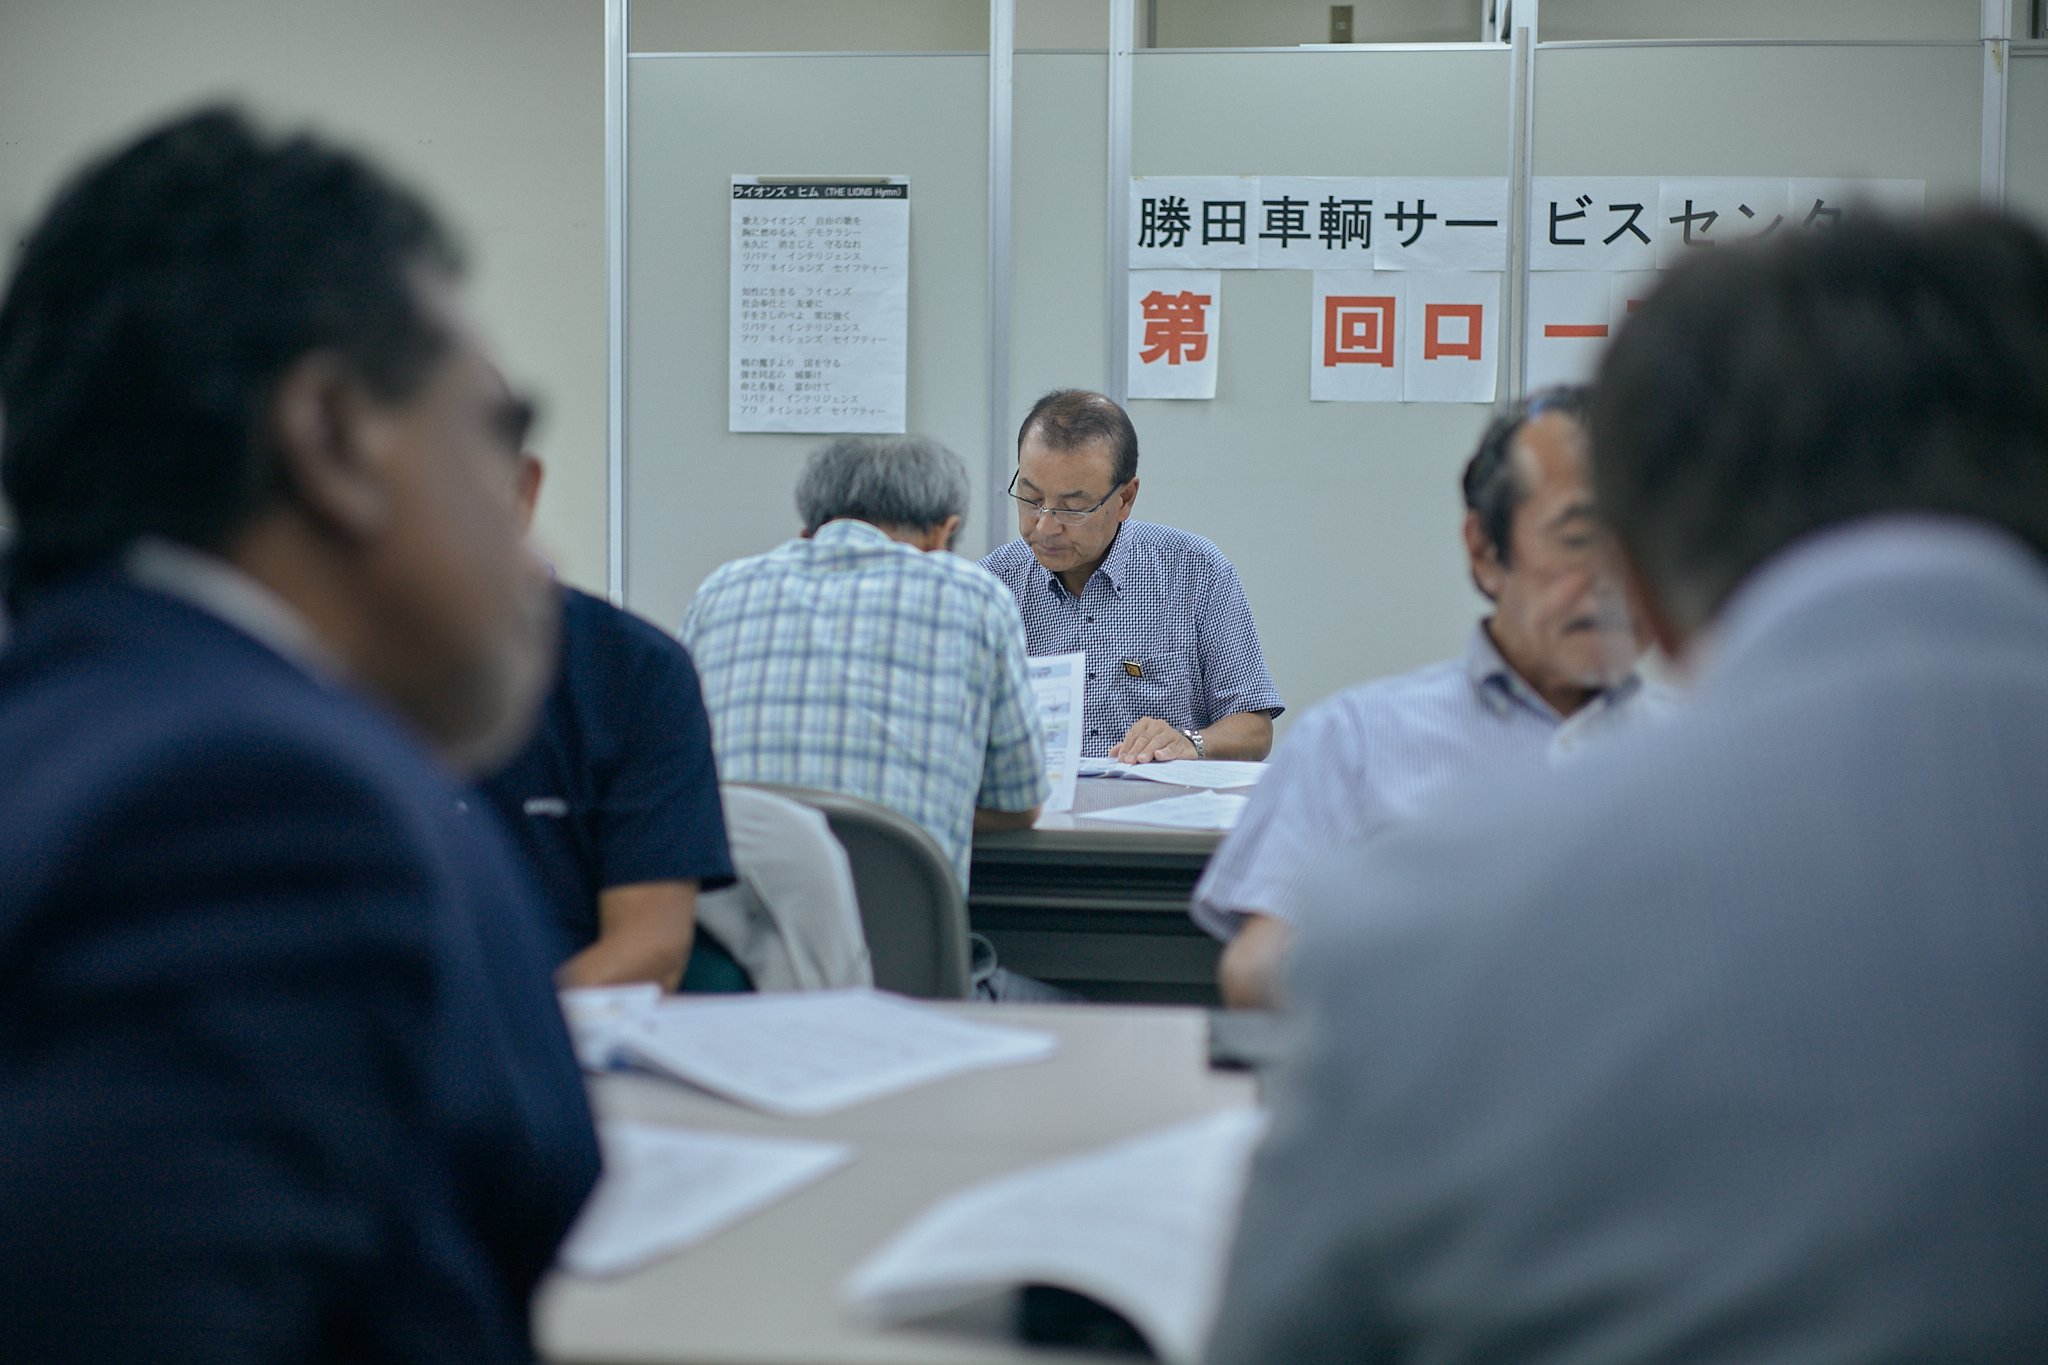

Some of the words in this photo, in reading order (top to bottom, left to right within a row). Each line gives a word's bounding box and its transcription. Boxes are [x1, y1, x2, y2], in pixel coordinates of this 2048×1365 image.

[734, 186, 819, 198] ライオンズ・ヒム
[847, 186, 873, 198] LIONS
[742, 216, 807, 226] 歌えライオンズ
[816, 216, 862, 226] 自由の歌を
[806, 228, 862, 237] デモクラシー
[742, 240, 769, 249] 永久に
[779, 240, 815, 249] 消さじと
[824, 240, 862, 249] 守るなれ
[788, 252, 861, 261] インテリジェンス
[742, 264, 760, 273] アワ
[770, 264, 824, 273] ネイションズ
[834, 264, 888, 273] セイフティー
[742, 287, 796, 297] 知性に生きる
[806, 287, 852, 297] ライオンズ
[741, 299, 787, 309] 社会奉仕と
[797, 299, 823, 309] 友愛に
[742, 311, 805, 320] 手をさしのべよ
[814, 311, 850, 320] 常に強く
[787, 323, 860, 332] インテリジェンス
[1140, 290, 1212, 366] 第
[741, 335, 759, 344] アワ
[769, 335, 823, 344] ネイションズ
[833, 335, 887, 344] セイフティー
[804, 358, 841, 368] 国を守る
[786, 394, 859, 404] インテリジェンス
[741, 406, 758, 415] アワ
[768, 406, 822, 415] ネイションズ
[831, 406, 886, 415] セイフティー
